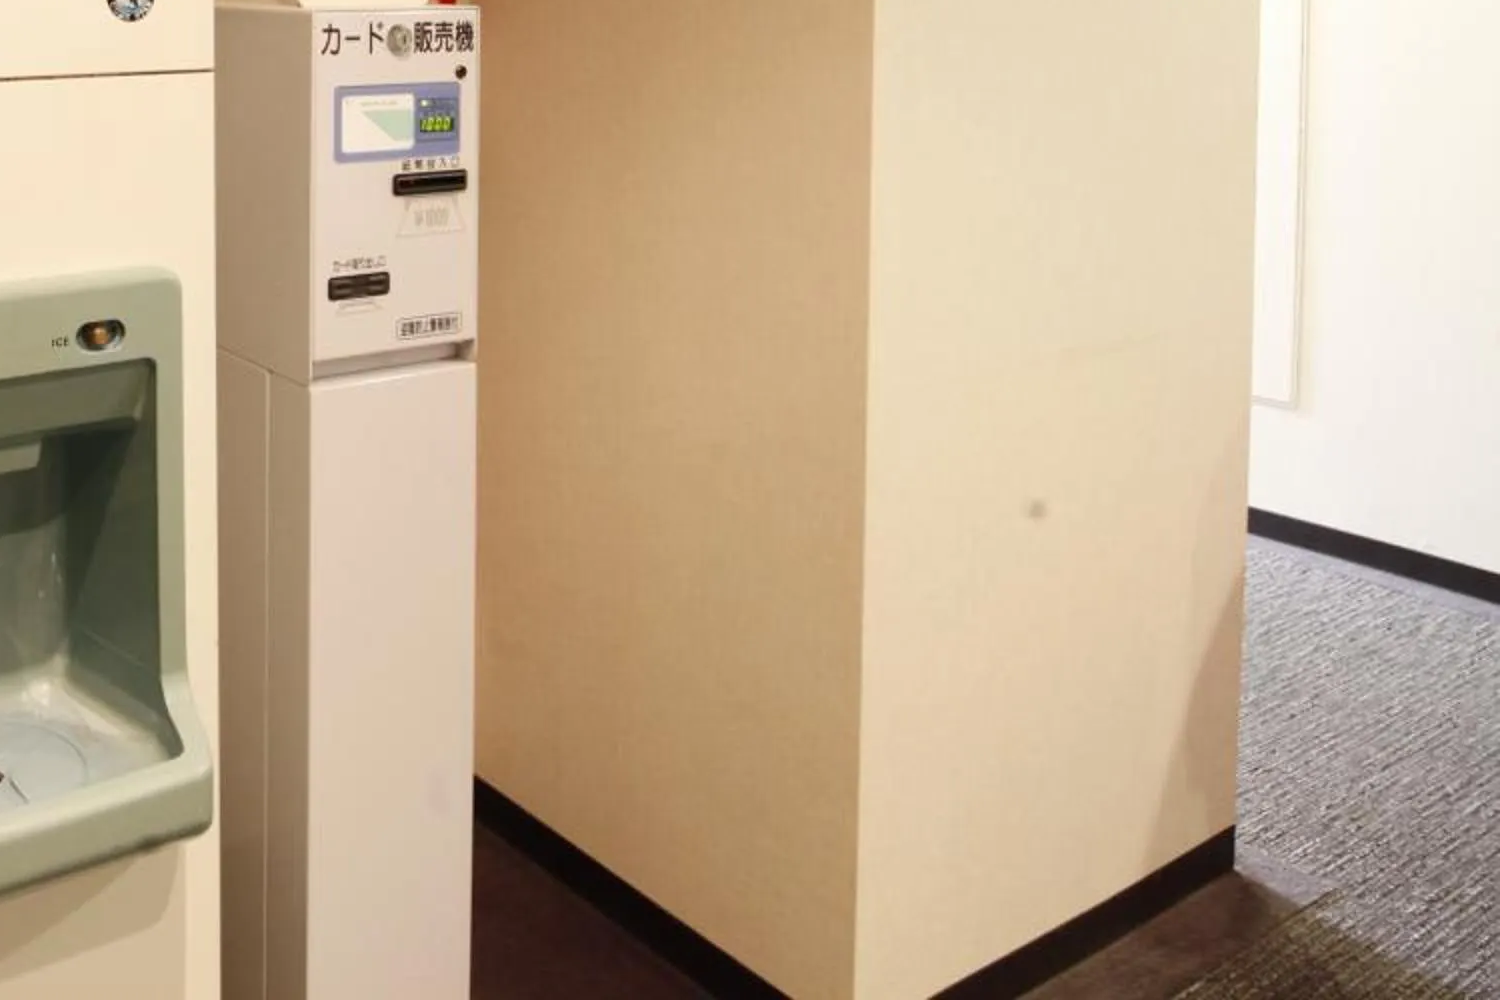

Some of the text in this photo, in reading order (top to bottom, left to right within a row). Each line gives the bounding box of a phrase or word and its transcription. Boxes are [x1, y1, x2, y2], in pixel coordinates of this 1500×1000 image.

[320, 20, 474, 56] カード 販売機
